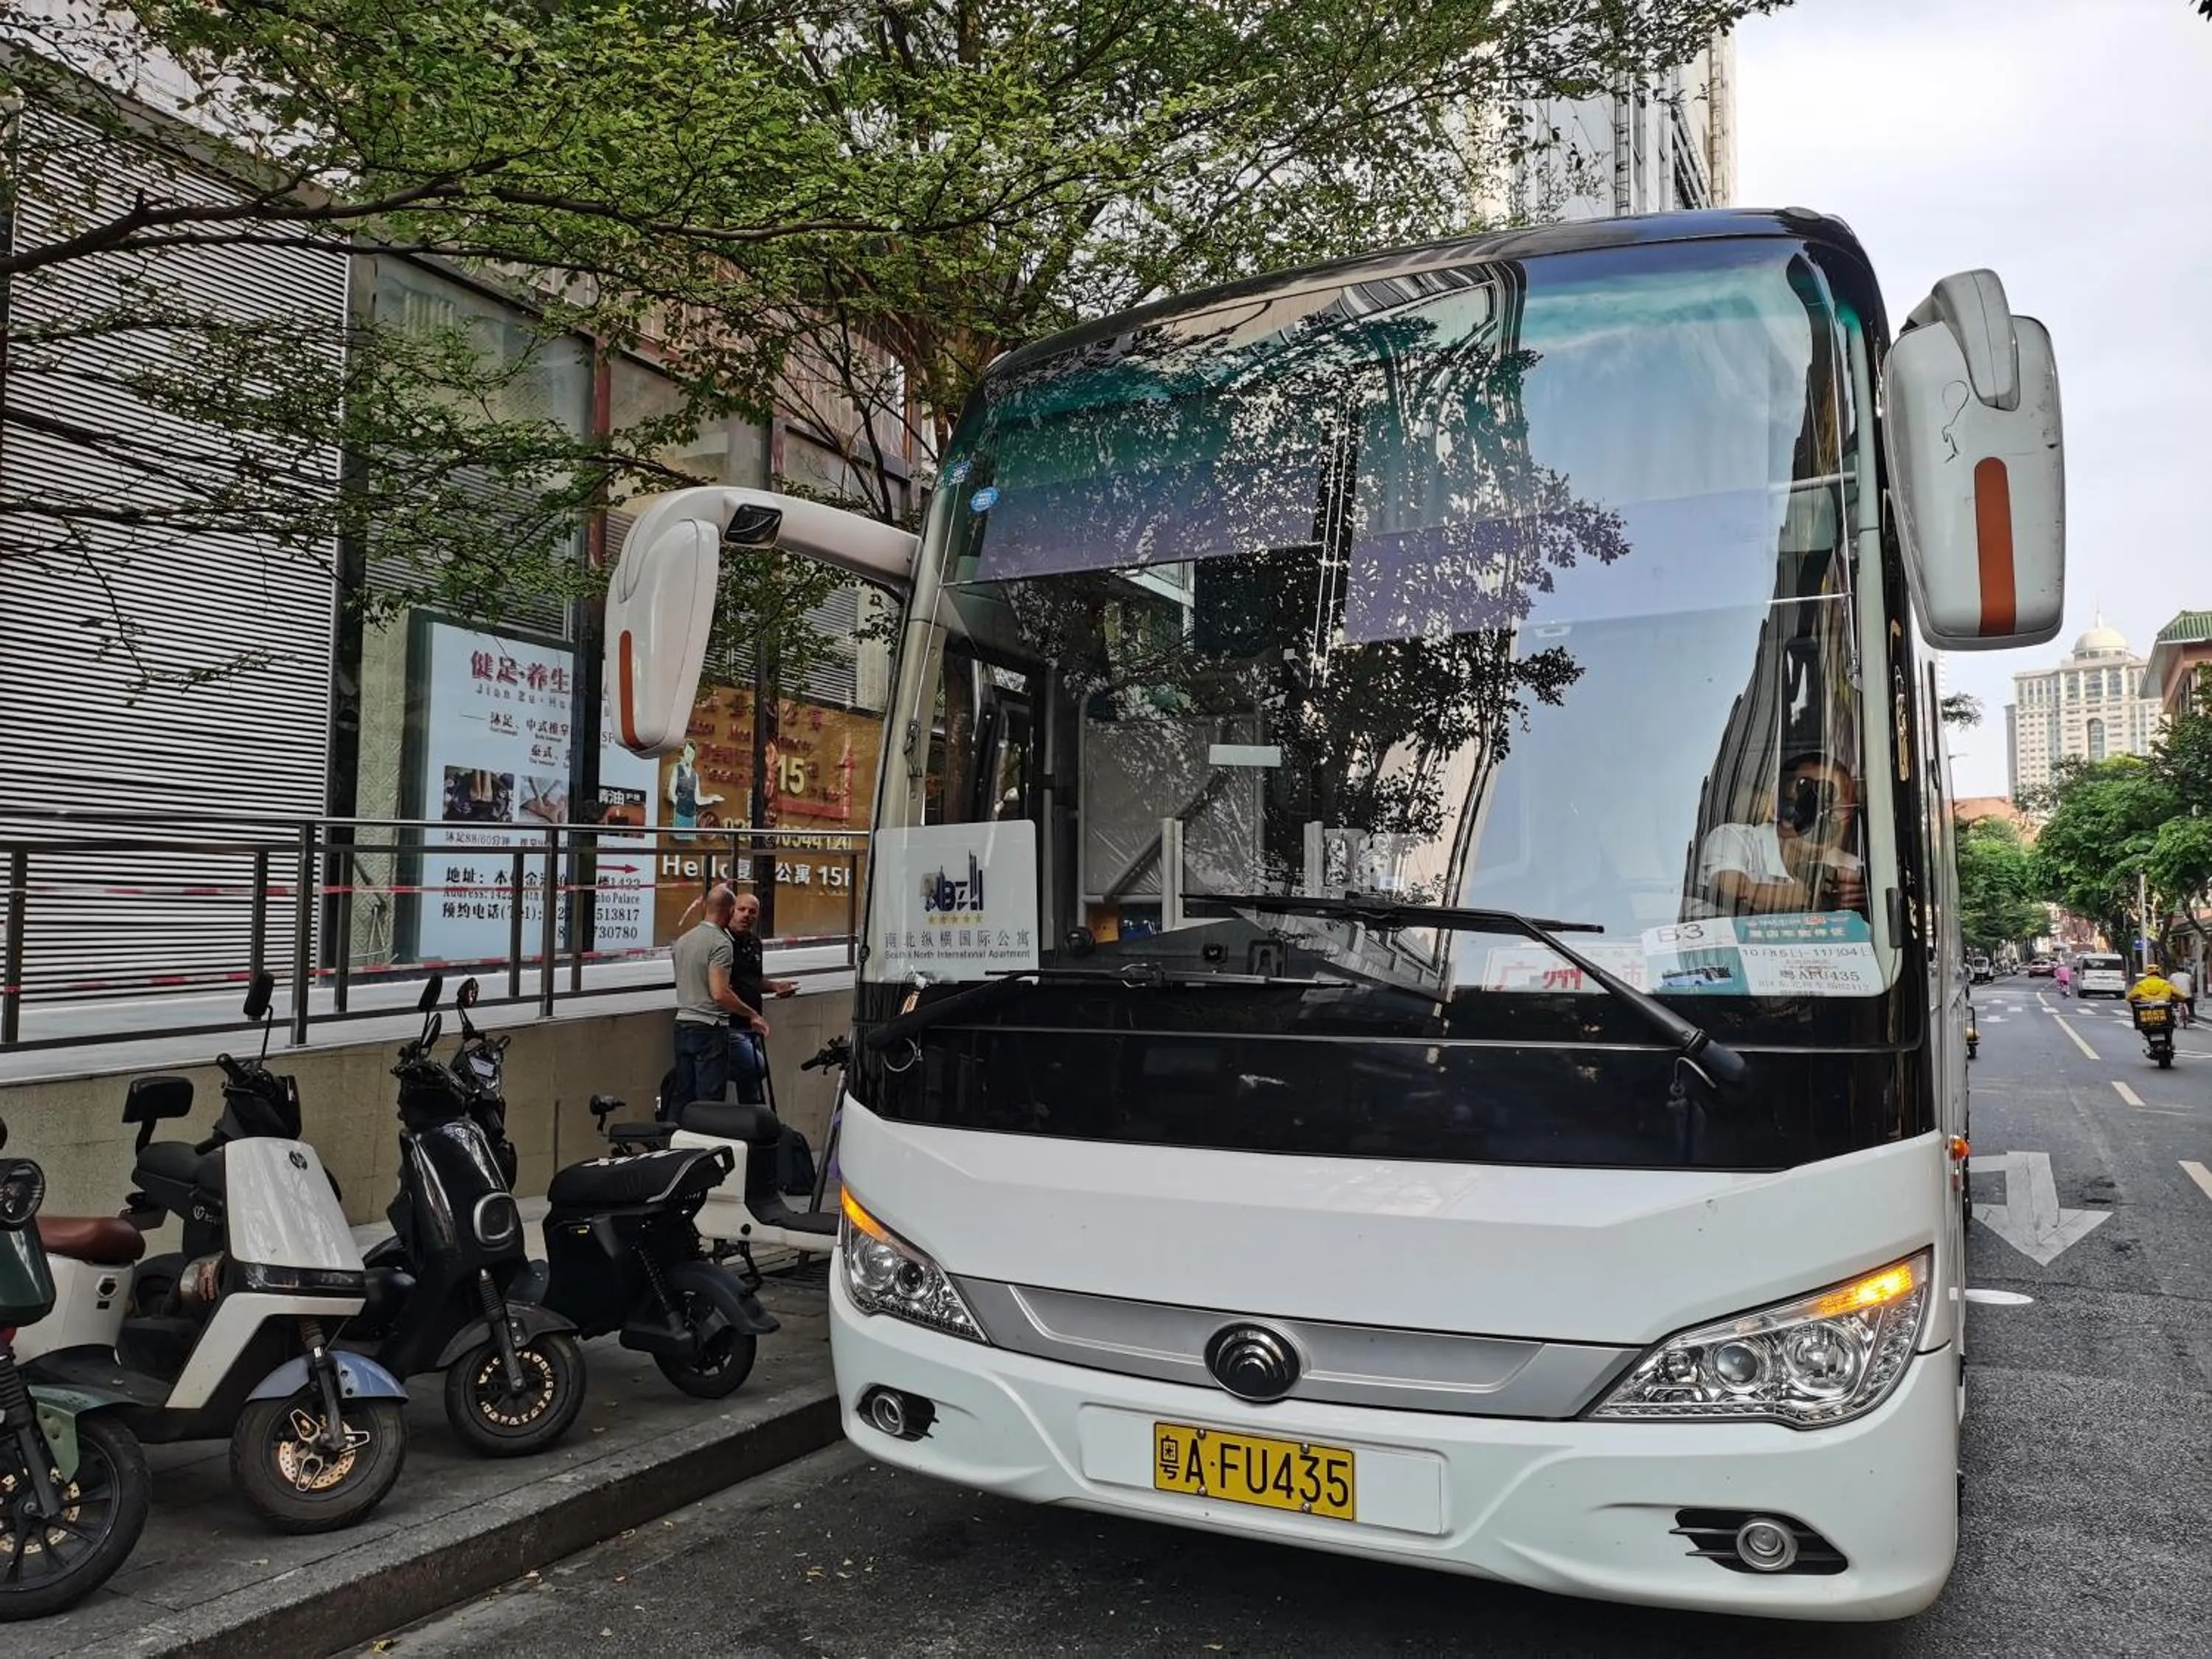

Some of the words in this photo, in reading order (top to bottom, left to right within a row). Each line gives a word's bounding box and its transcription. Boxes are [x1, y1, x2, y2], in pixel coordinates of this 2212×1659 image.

[776, 754, 805, 794] 15
[885, 929, 1030, 949] 南北纵横国际公寓
[937, 949, 986, 959] International
[988, 949, 1031, 959] Apartment
